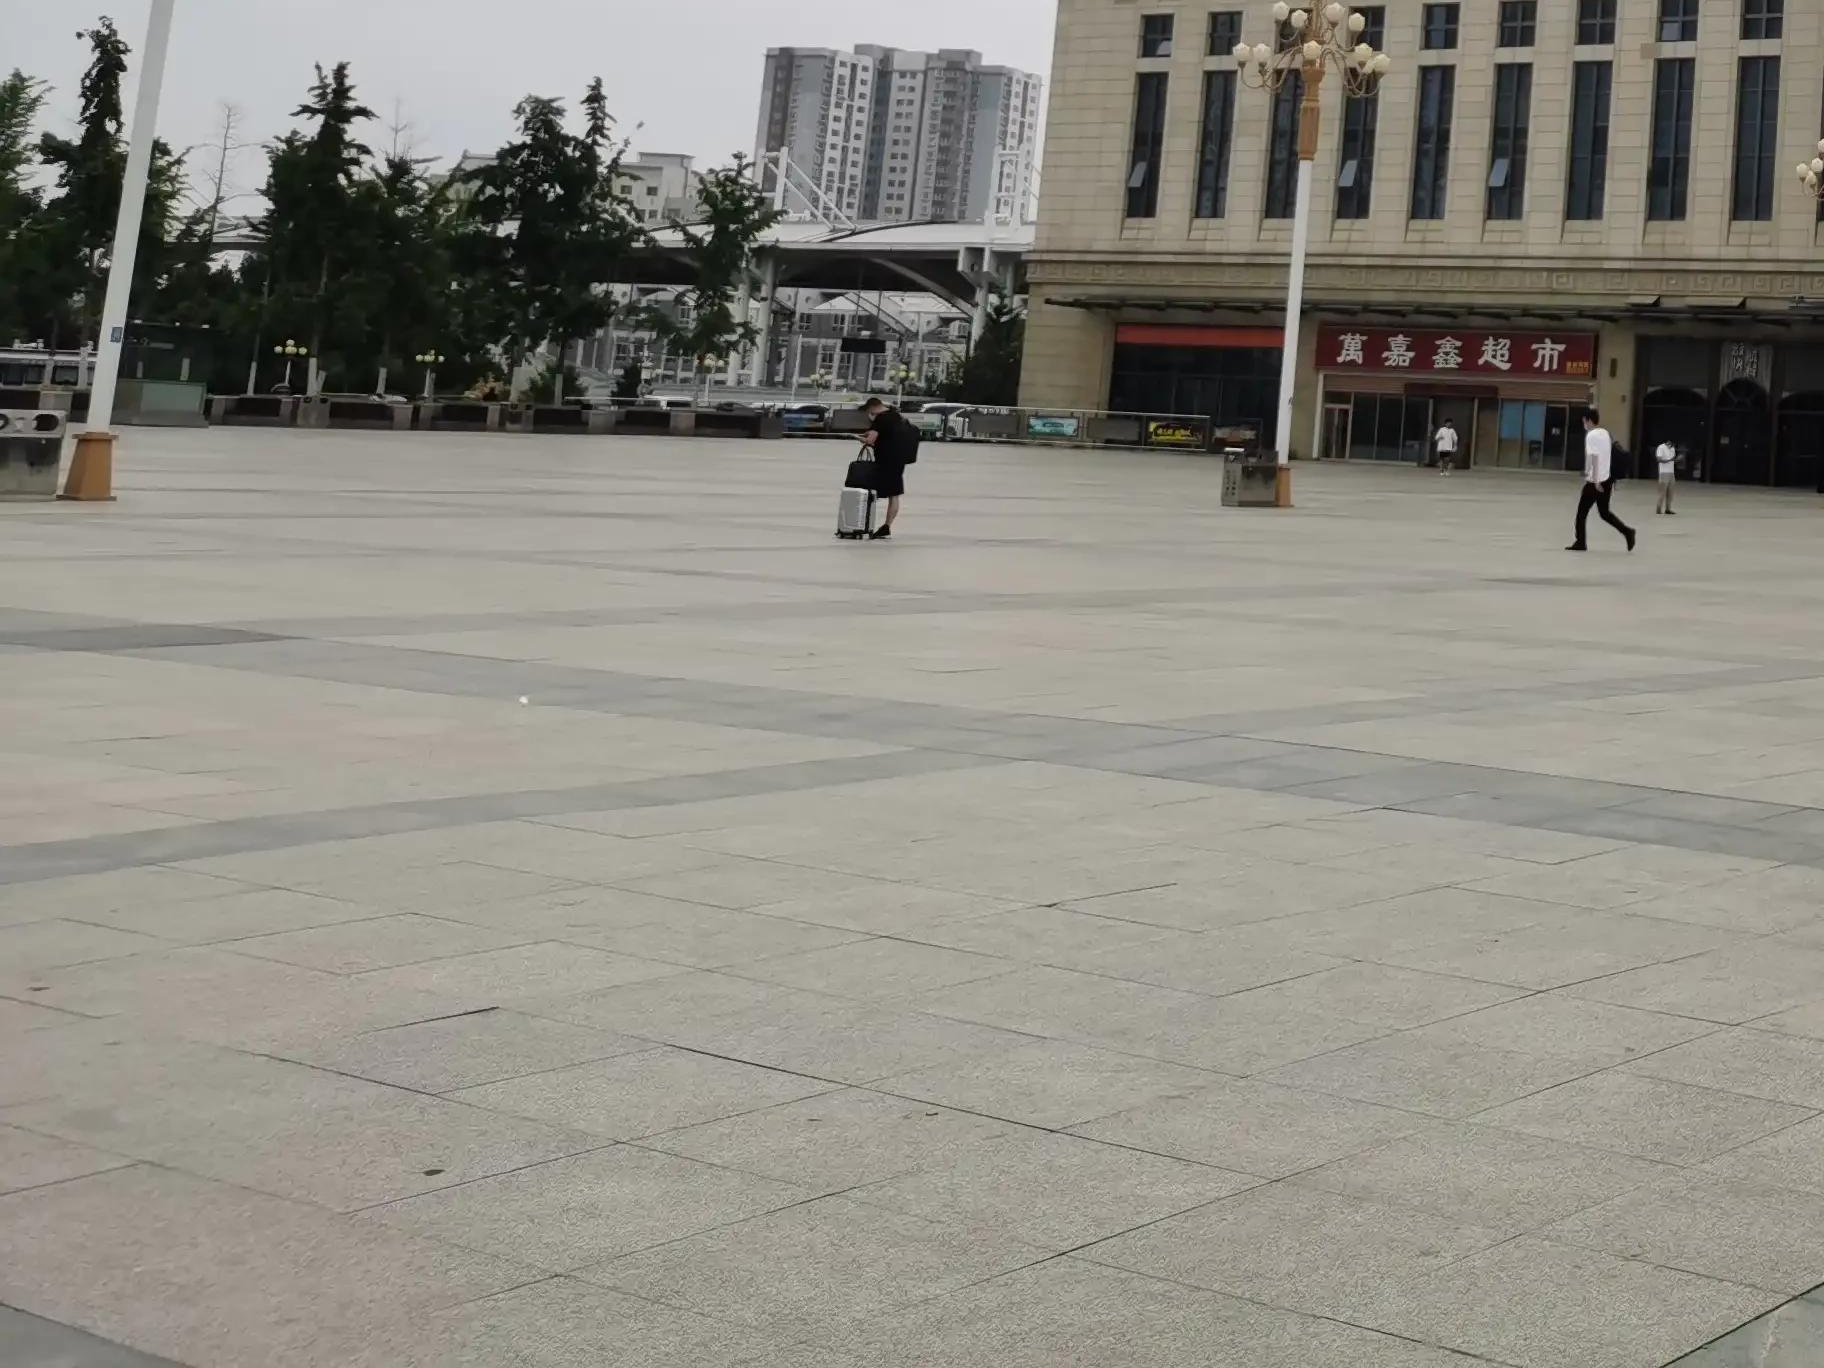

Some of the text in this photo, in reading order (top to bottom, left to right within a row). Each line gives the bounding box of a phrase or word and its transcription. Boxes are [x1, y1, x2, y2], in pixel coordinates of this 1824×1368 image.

[1336, 332, 1566, 372] 萬嘉鑫超市
